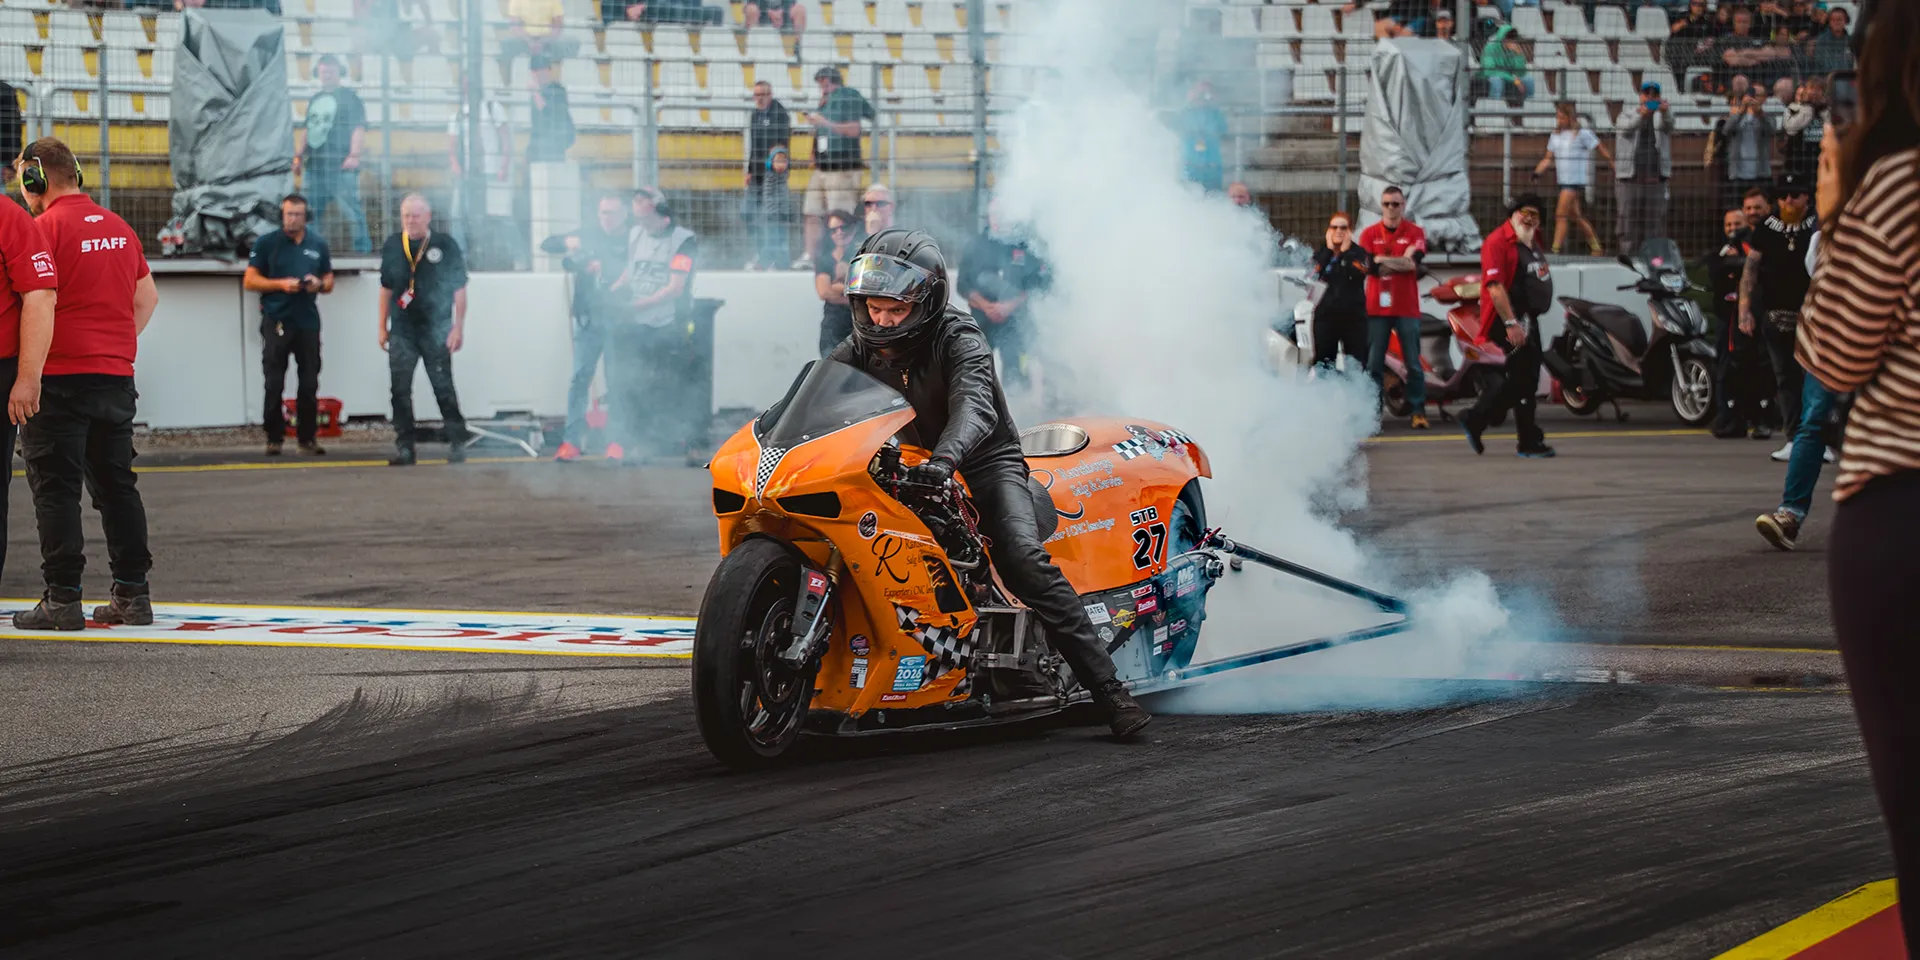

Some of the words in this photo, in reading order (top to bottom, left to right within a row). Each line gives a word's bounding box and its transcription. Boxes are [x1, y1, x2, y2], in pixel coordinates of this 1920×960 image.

[81, 237, 127, 253] STAFF
[1130, 506, 1158, 525] STB
[871, 532, 910, 584] R
[1132, 522, 1167, 570] 27
